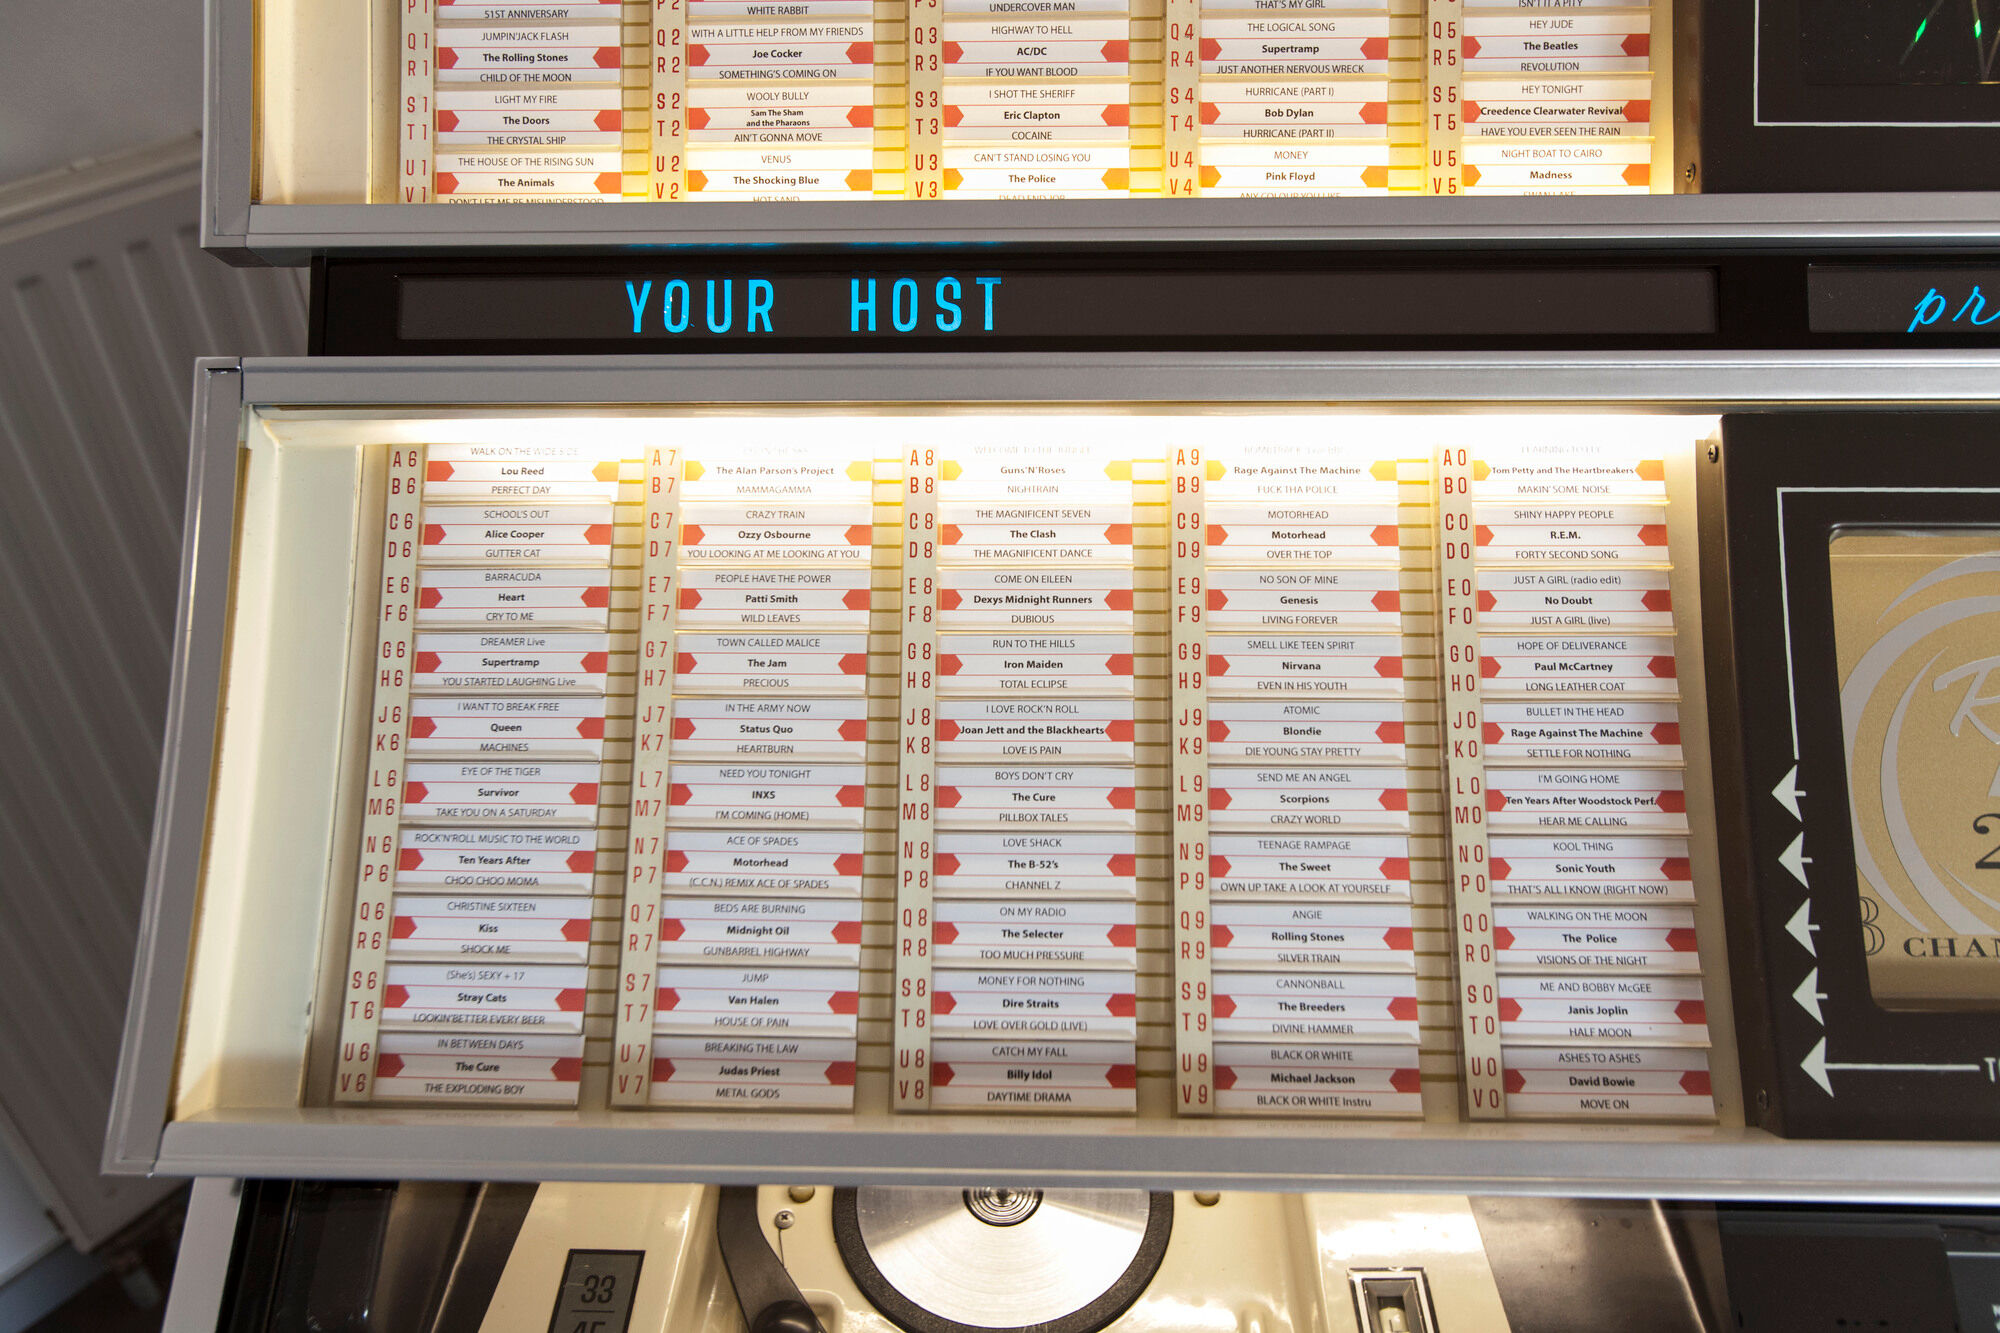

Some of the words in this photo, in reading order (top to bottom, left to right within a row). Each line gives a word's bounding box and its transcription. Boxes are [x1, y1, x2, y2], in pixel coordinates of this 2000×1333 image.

[485, 9, 505, 19] 51ST
[508, 8, 568, 19] ANNIVERSARY
[1530, 19, 1548, 30] HEY
[1550, 19, 1573, 30] JUDE
[541, 31, 568, 41] FLASH
[1262, 44, 1319, 55] Supertramp
[1523, 41, 1541, 51] The
[1544, 40, 1578, 51] Beatles
[753, 49, 768, 59] Joe
[771, 48, 802, 59] Cocker
[1017, 46, 1047, 57] AC/DC
[483, 52, 500, 63] The
[502, 53, 534, 64] Rolling
[537, 53, 568, 62] Stones
[1521, 61, 1579, 72] REVOLUTION
[747, 91, 779, 102] WOOLY
[782, 91, 809, 102] BULLY
[1004, 110, 1021, 120] Eric
[1024, 110, 1060, 121] Clapton
[1265, 108, 1284, 118] Bob
[1286, 108, 1313, 119] Dylan
[1481, 106, 1531, 116] Creedence
[1534, 106, 1585, 116] Clearwater
[1588, 106, 1622, 116] Revival
[503, 115, 520, 125] The
[523, 115, 549, 125] Doors
[1012, 130, 1052, 141] COCAINE
[761, 154, 792, 164] VENUS
[733, 175, 750, 185] The
[753, 175, 796, 186] Shocking
[799, 175, 819, 185] Blue
[1009, 174, 1025, 184] The
[1029, 174, 1055, 184] Police
[1266, 171, 1286, 181] Pink
[1289, 171, 1315, 182] Floyd
[1530, 170, 1572, 180] Madness
[498, 178, 515, 188] The
[517, 178, 555, 188] Animals
[625, 279, 775, 334] YOUR
[850, 276, 1002, 332] HOST
[502, 467, 518, 476] Lou
[521, 466, 544, 476] Reed
[485, 529, 508, 539] Alice
[510, 529, 544, 540] Cooper
[738, 530, 761, 541] Ozzy
[764, 530, 811, 539] Osbourne
[1010, 529, 1027, 539] The
[1030, 529, 1056, 539] Clash
[1272, 530, 1325, 540] Motorhead
[1551, 530, 1580, 540] R.E.M.
[485, 572, 541, 582] BARRACUDA
[499, 592, 525, 602] Heart
[746, 594, 768, 604] Patti
[770, 594, 798, 604] Smith
[974, 594, 1003, 605] Dexys
[1005, 594, 1049, 605] Midnight
[1053, 595, 1092, 604] Runners
[1280, 595, 1318, 605] Genesis
[1545, 596, 1559, 605] No
[1561, 596, 1592, 605] Doubt
[1012, 614, 1054, 624] DUBIOUS
[482, 657, 539, 668] Supertramp
[747, 658, 765, 668] The
[767, 658, 787, 668] Jam
[1005, 659, 1023, 669] Iron
[1027, 659, 1063, 669] Maiden
[1282, 661, 1321, 671] Nirvana
[1534, 662, 1556, 672] Paul
[1559, 662, 1613, 673] McCartney
[1283, 705, 1320, 716] ATOMIC
[491, 722, 522, 733] Queen
[740, 724, 770, 734] Status
[773, 724, 793, 735] Quo
[961, 725, 983, 735] Joan
[986, 725, 1004, 735] Jett
[1007, 725, 1025, 735] and
[1028, 725, 1044, 735] the
[1046, 725, 1104, 735] Blackhearts
[1283, 726, 1321, 736] Blondie
[1511, 728, 1536, 739] Rage
[1538, 728, 1577, 739] Against
[1579, 728, 1598, 739] The
[1600, 728, 1644, 739] Machine
[480, 742, 528, 752] MACHINES
[737, 744, 794, 754] HEARTBURN
[478, 787, 519, 797] Survivor
[752, 790, 775, 800] INXS
[1012, 792, 1030, 802] The
[1033, 792, 1056, 802] Cure
[1280, 794, 1329, 805] Scorpions
[1507, 795, 1522, 805] Ten
[1525, 796, 1550, 805] Years
[1553, 795, 1576, 806] After
[1578, 796, 1632, 806] Woodstock
[459, 855, 475, 865] Ten
[478, 855, 503, 865] Years
[505, 855, 530, 866] After
[733, 857, 788, 868] Motorhead
[1008, 859, 1026, 869] The
[1029, 859, 1058, 869] B-52's
[1279, 861, 1298, 872] The
[1301, 862, 1330, 872] Sweet
[1556, 863, 1583, 873] Sonic
[1585, 863, 1615, 873] Youth
[1292, 909, 1322, 920] ANGIE
[479, 923, 498, 933] Kiss
[727, 926, 772, 937] Midnight
[775, 926, 789, 936] Oil
[1001, 928, 1020, 939] The
[1023, 928, 1063, 939] Selecter
[1272, 932, 1307, 943] Rolling
[1310, 931, 1344, 942] Stones
[1562, 933, 1581, 944] The
[1586, 933, 1617, 944] Police
[1276, 978, 1344, 989] CANNONBALL
[458, 993, 483, 1004] Stray
[486, 992, 507, 1003] Cats
[728, 995, 747, 1005] Van
[750, 995, 779, 1006] Halen
[1003, 998, 1024, 1009] Dire
[1027, 998, 1059, 1009] Straits
[1278, 1001, 1297, 1012] The
[1300, 1001, 1345, 1012] Breeders
[1569, 1005, 1594, 1015] Janis
[1597, 1005, 1628, 1016] Joplin
[456, 1061, 474, 1072] The
[476, 1061, 500, 1072] Cure
[719, 1065, 748, 1076] Judas
[751, 1065, 780, 1076] Priest
[1007, 1069, 1029, 1082] Billy
[1032, 1069, 1052, 1080] Idol
[1271, 1072, 1311, 1083] Michael
[1314, 1073, 1355, 1084] Jackson
[1569, 1075, 1600, 1086] David
[1602, 1076, 1634, 1087] Bowie
[1581, 1098, 1610, 1109] MOVE
[1613, 1098, 1629, 1109] ON
[581, 1274, 616, 1304] 33
